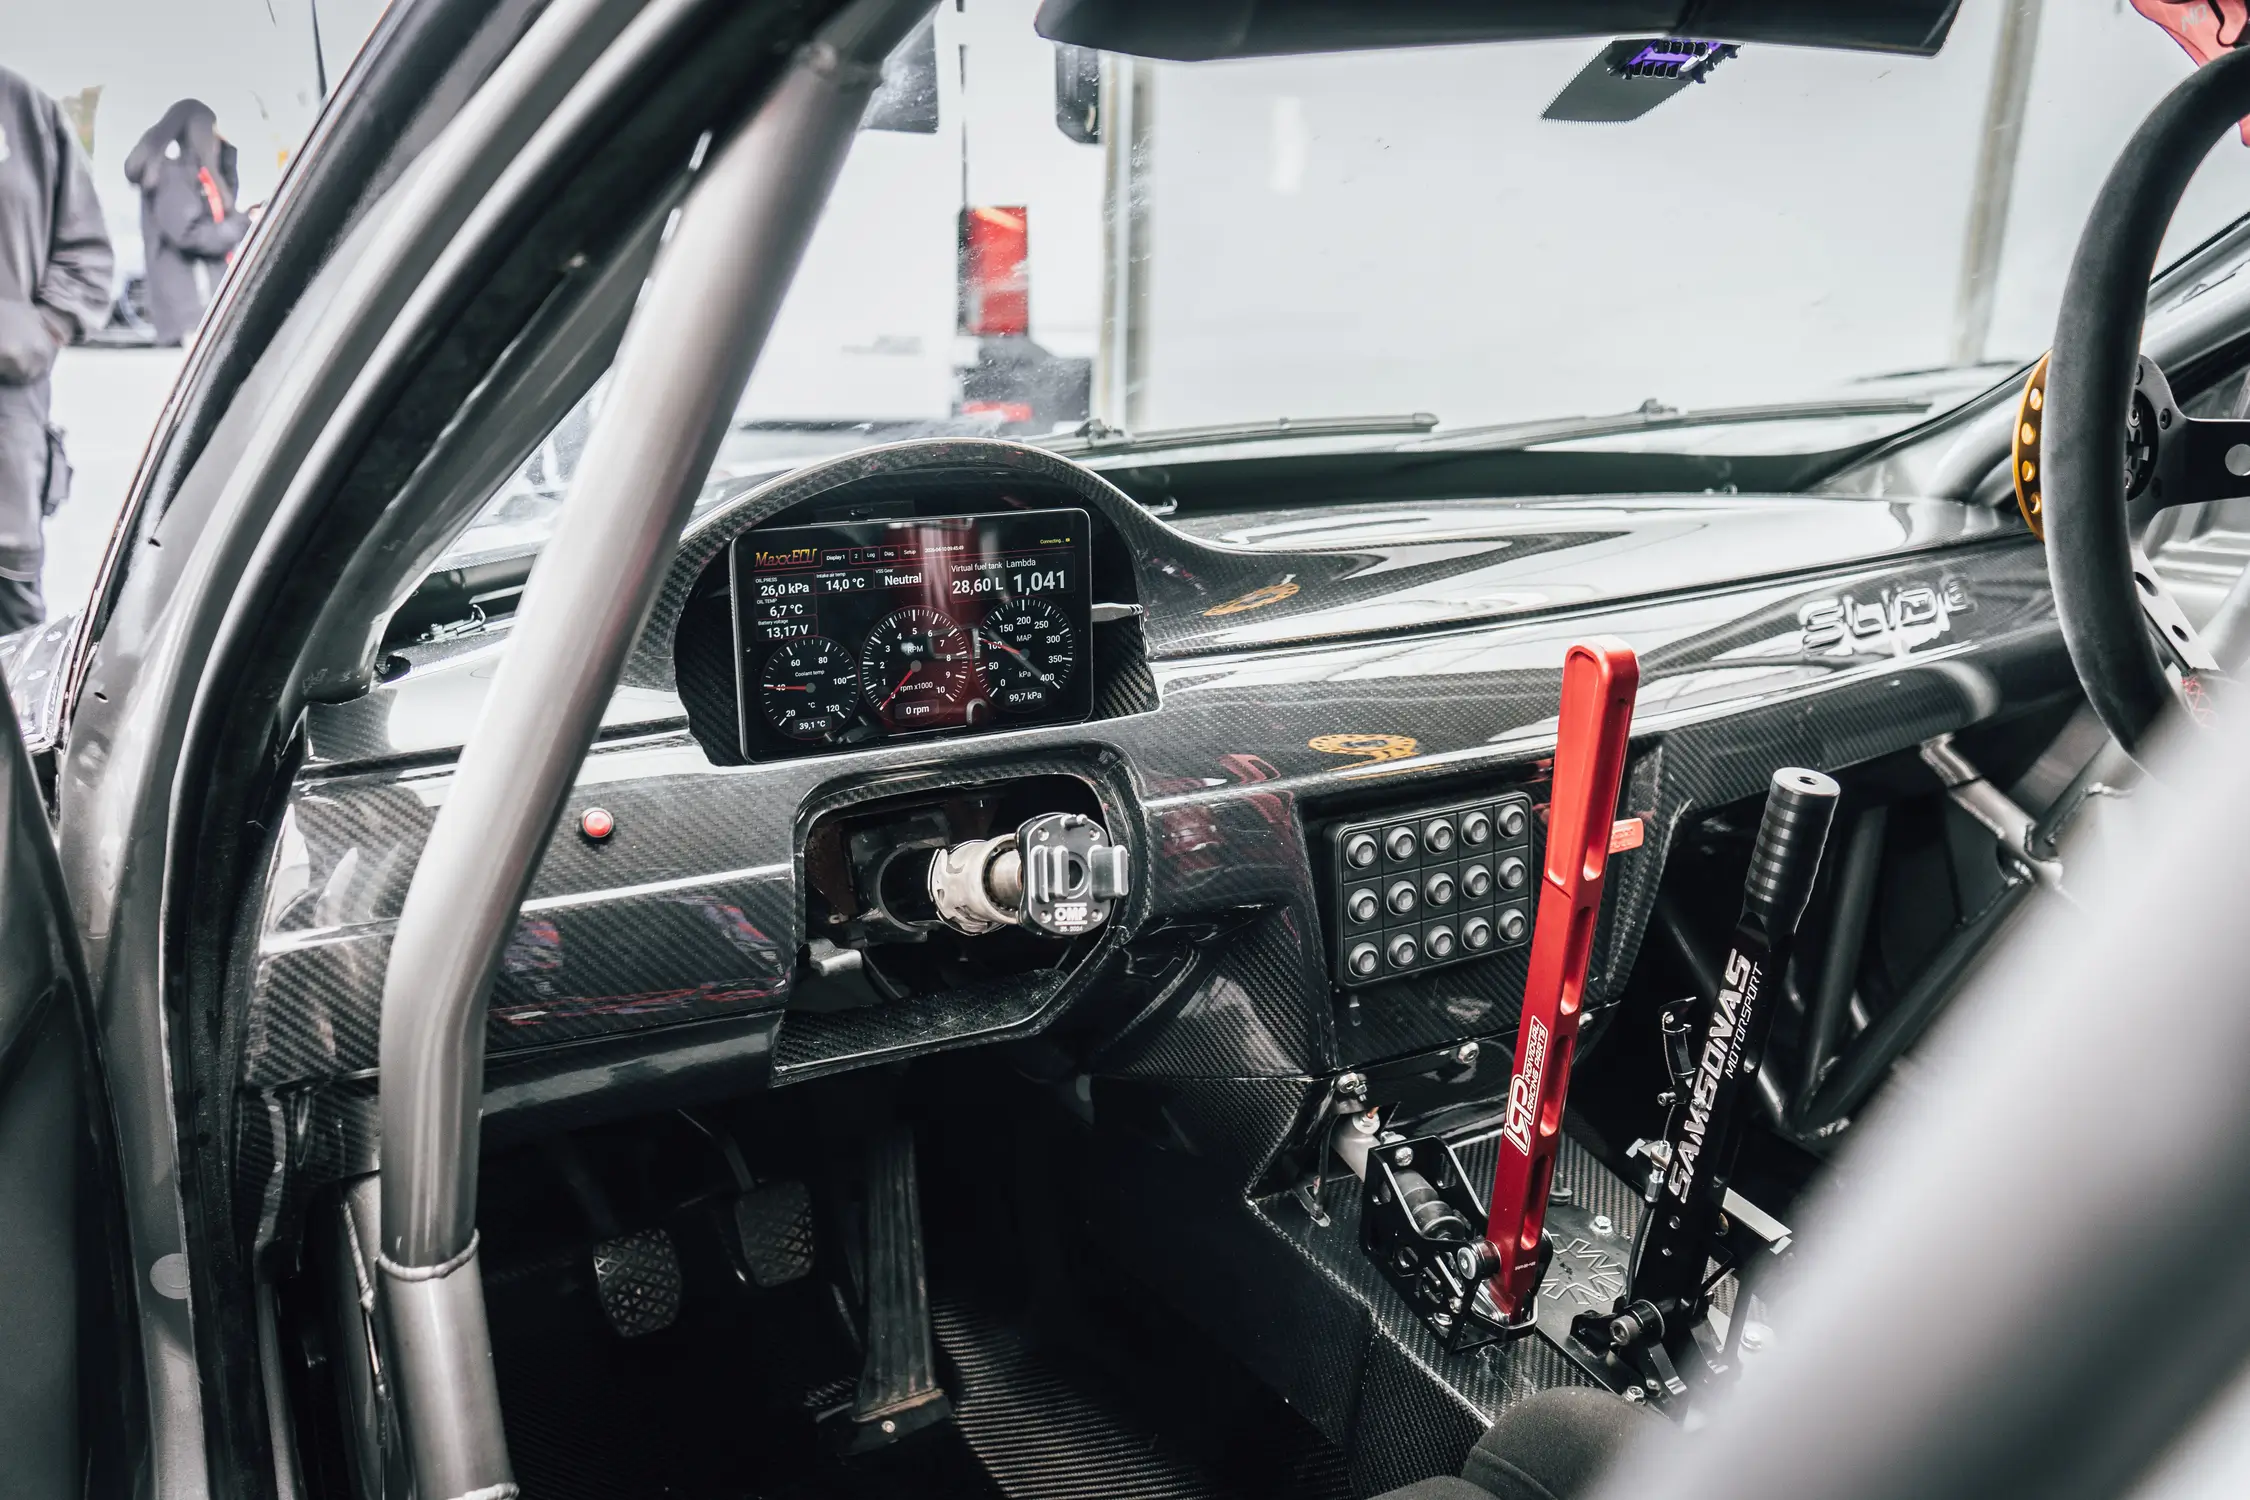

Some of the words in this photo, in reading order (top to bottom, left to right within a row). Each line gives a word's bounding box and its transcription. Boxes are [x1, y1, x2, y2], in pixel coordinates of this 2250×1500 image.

[755, 548, 817, 568] MaxxECU
[1006, 558, 1036, 568] Lambda
[951, 564, 973, 572] Virtual
[974, 563, 987, 571] fuel
[988, 562, 1003, 570] tank
[884, 573, 922, 586] Neutral
[1014, 570, 1065, 596] 1,041
[760, 584, 786, 597] 26,0
[788, 583, 810, 593] kPa
[826, 579, 850, 592] 14,0
[852, 578, 865, 588] °C
[952, 578, 991, 596] 28,60
[995, 577, 1003, 590] L
[770, 606, 786, 618] 6,7
[790, 604, 803, 614] °C
[1016, 616, 1031, 625] 200
[1034, 620, 1048, 629] 250
[766, 625, 797, 639] 13,17
[800, 624, 808, 635] V
[999, 624, 1014, 633] 150
[1016, 634, 1032, 642] MAP
[1046, 635, 1060, 644] 300
[908, 645, 923, 653] RPM
[791, 659, 800, 667] 60
[818, 656, 828, 664] 80
[1048, 655, 1062, 664] 350
[988, 662, 998, 670] 50
[1018, 670, 1031, 678] kPa
[1040, 673, 1054, 682] 400
[900, 685, 913, 693] rpm
[914, 682, 933, 690] x1000
[1009, 692, 1026, 702] 99,7
[1027, 691, 1042, 700] kPa
[826, 704, 839, 712] 120
[913, 707, 929, 716] rpm
[799, 722, 815, 730] 39,1
[1054, 907, 1087, 921] OMP
[1725, 962, 1763, 1080] MOTORSPORT
[1524, 1024, 1540, 1084] INDIVIDUAL
[1526, 1068, 1539, 1112] RACING
[1535, 1028, 1546, 1068] PARTS
[1668, 948, 1752, 1204] SAMSONAS
